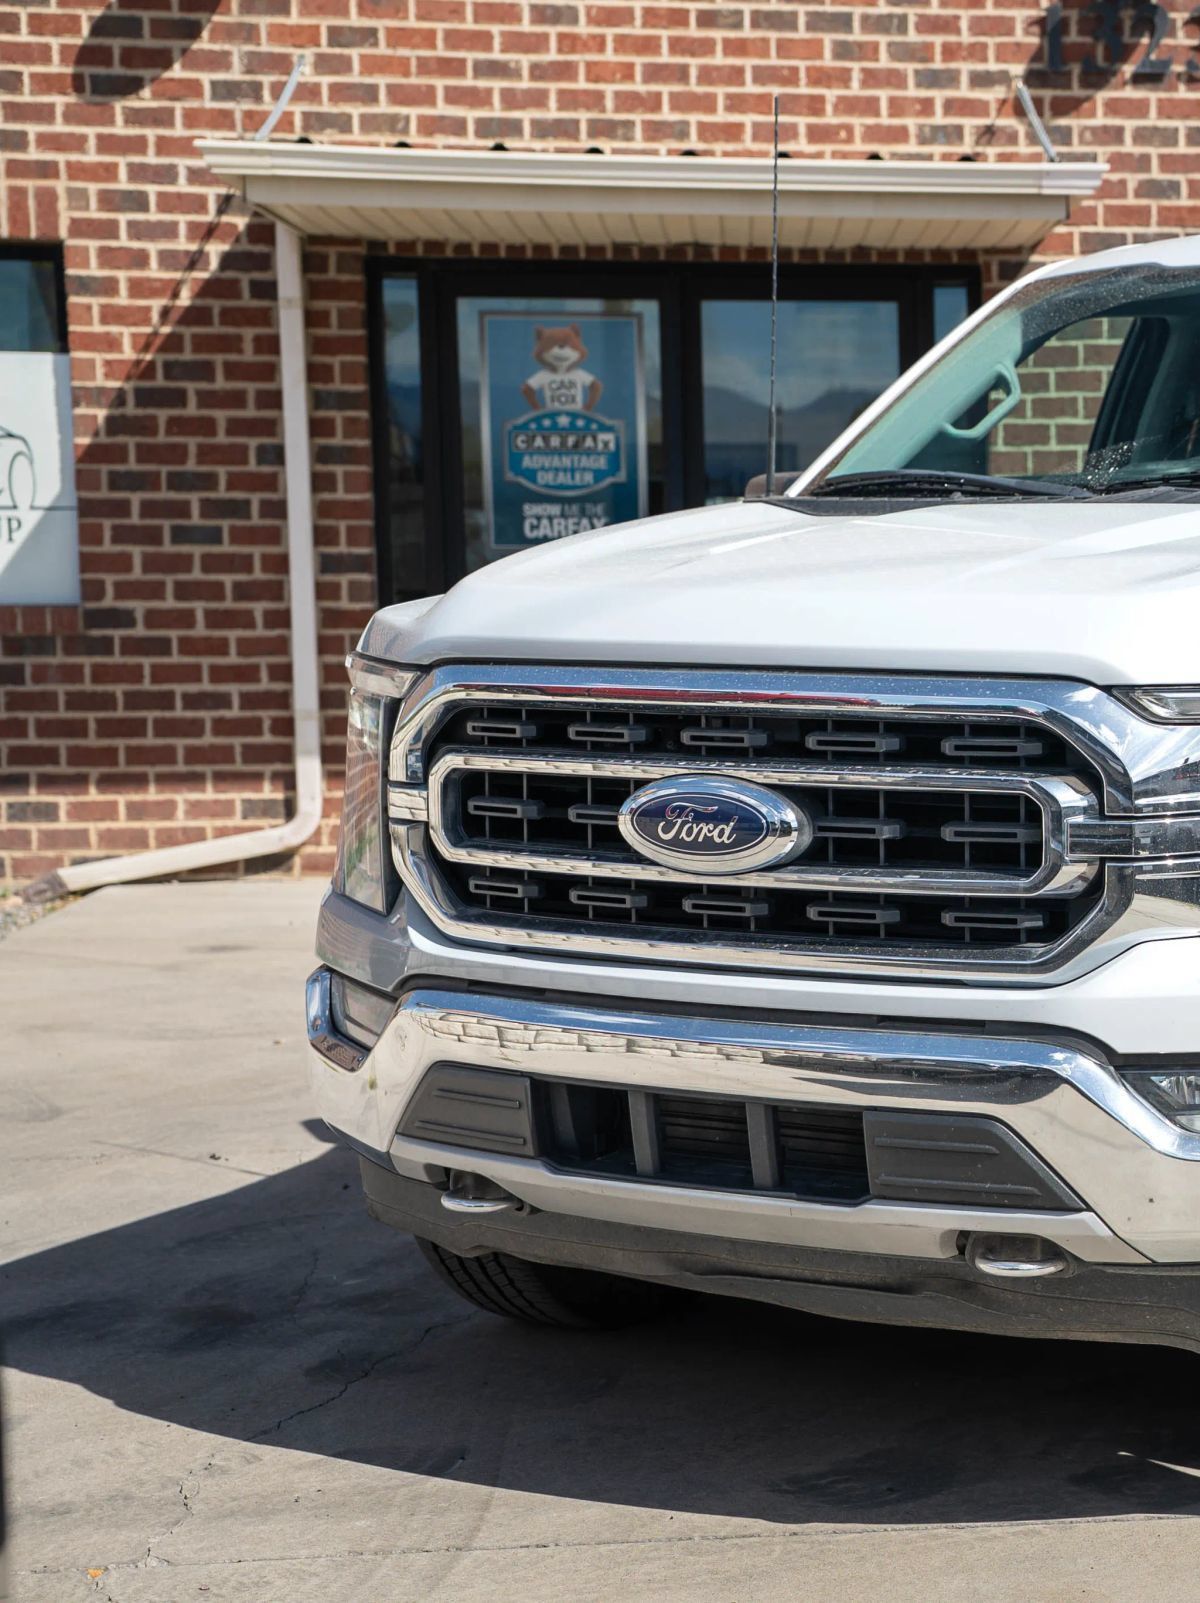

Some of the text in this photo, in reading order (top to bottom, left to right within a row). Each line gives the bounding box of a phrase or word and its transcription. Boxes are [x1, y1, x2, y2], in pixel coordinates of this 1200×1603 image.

[549, 380, 577, 391] CAR
[551, 393, 577, 405] FOX
[516, 433, 615, 451] CARFAX
[522, 454, 608, 470] ADVANTAGE
[536, 471, 594, 486] DEALER
[522, 503, 562, 517] SHOW
[657, 802, 739, 844] Ford
